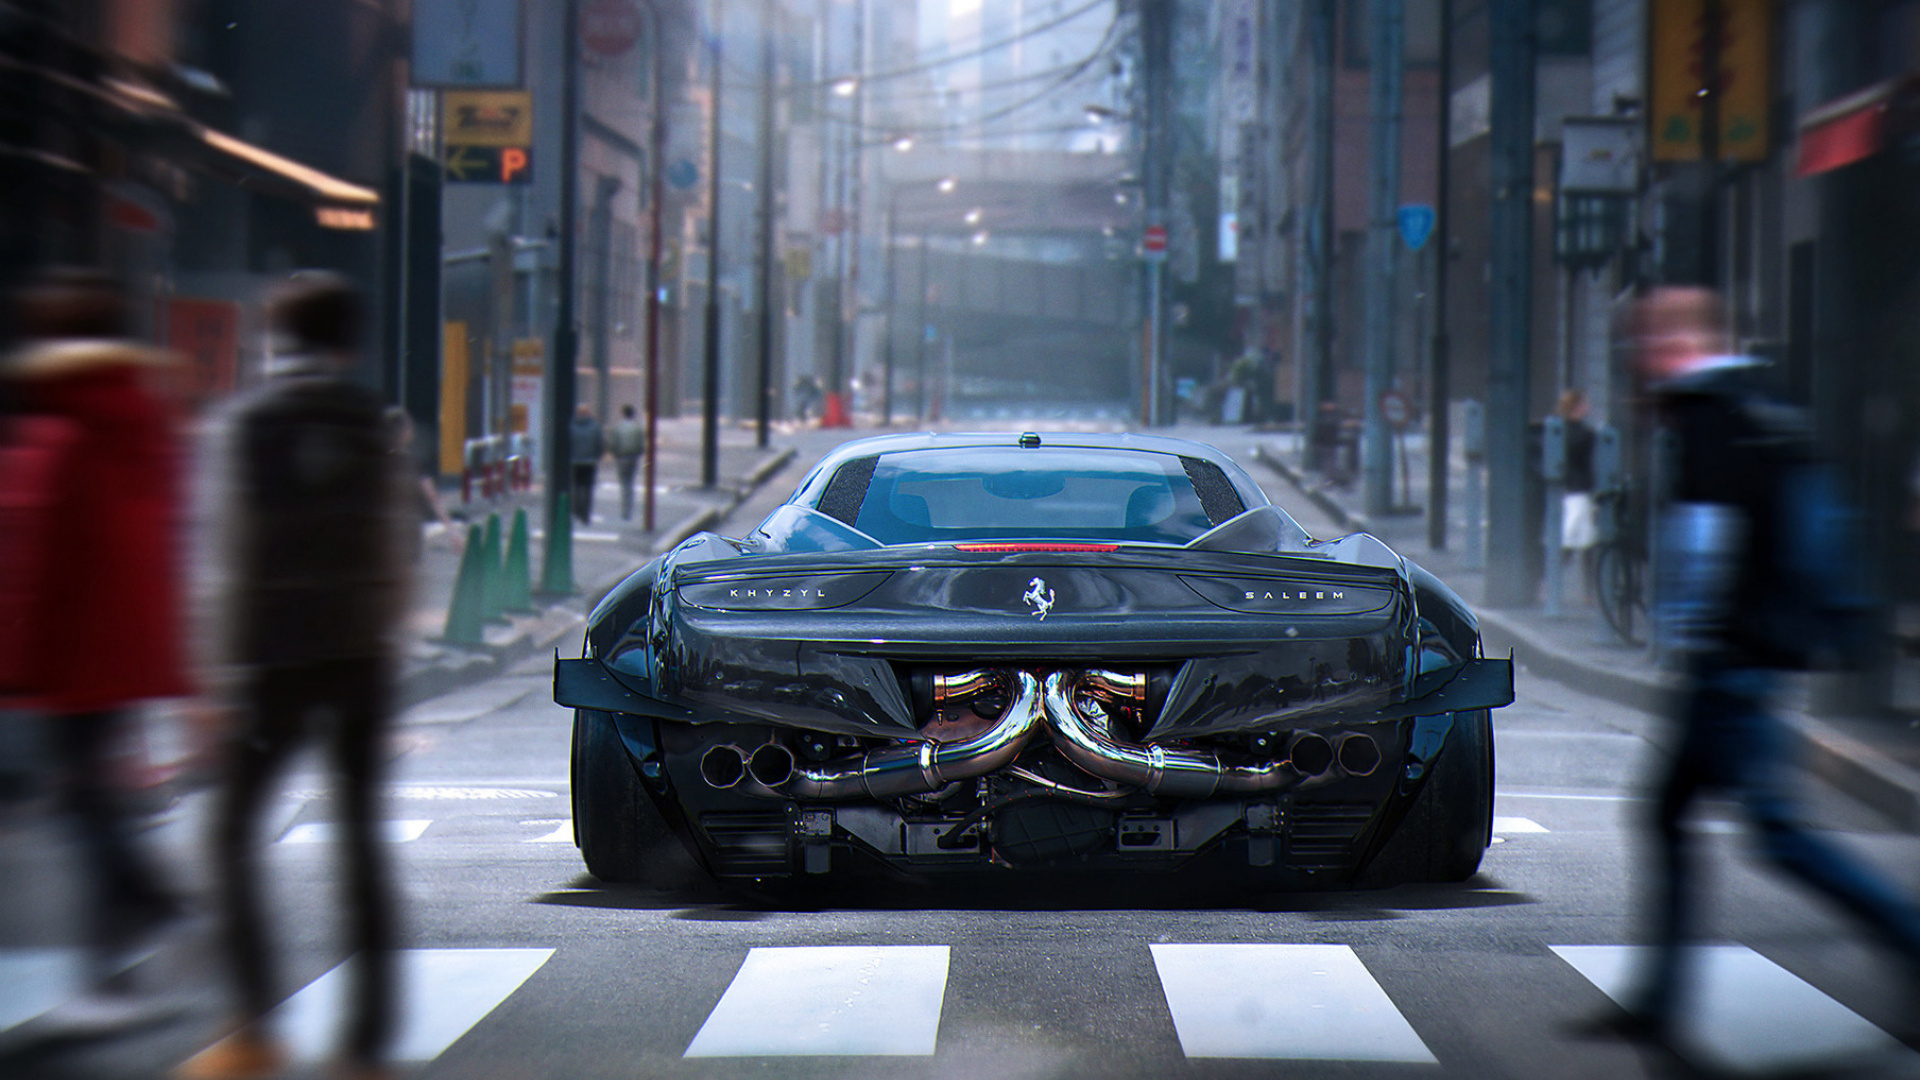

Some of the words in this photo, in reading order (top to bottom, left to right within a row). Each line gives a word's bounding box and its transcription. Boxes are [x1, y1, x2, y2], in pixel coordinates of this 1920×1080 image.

[501, 148, 526, 183] P
[730, 589, 825, 597] KHYZYL
[1244, 591, 1343, 599] SALEEM
